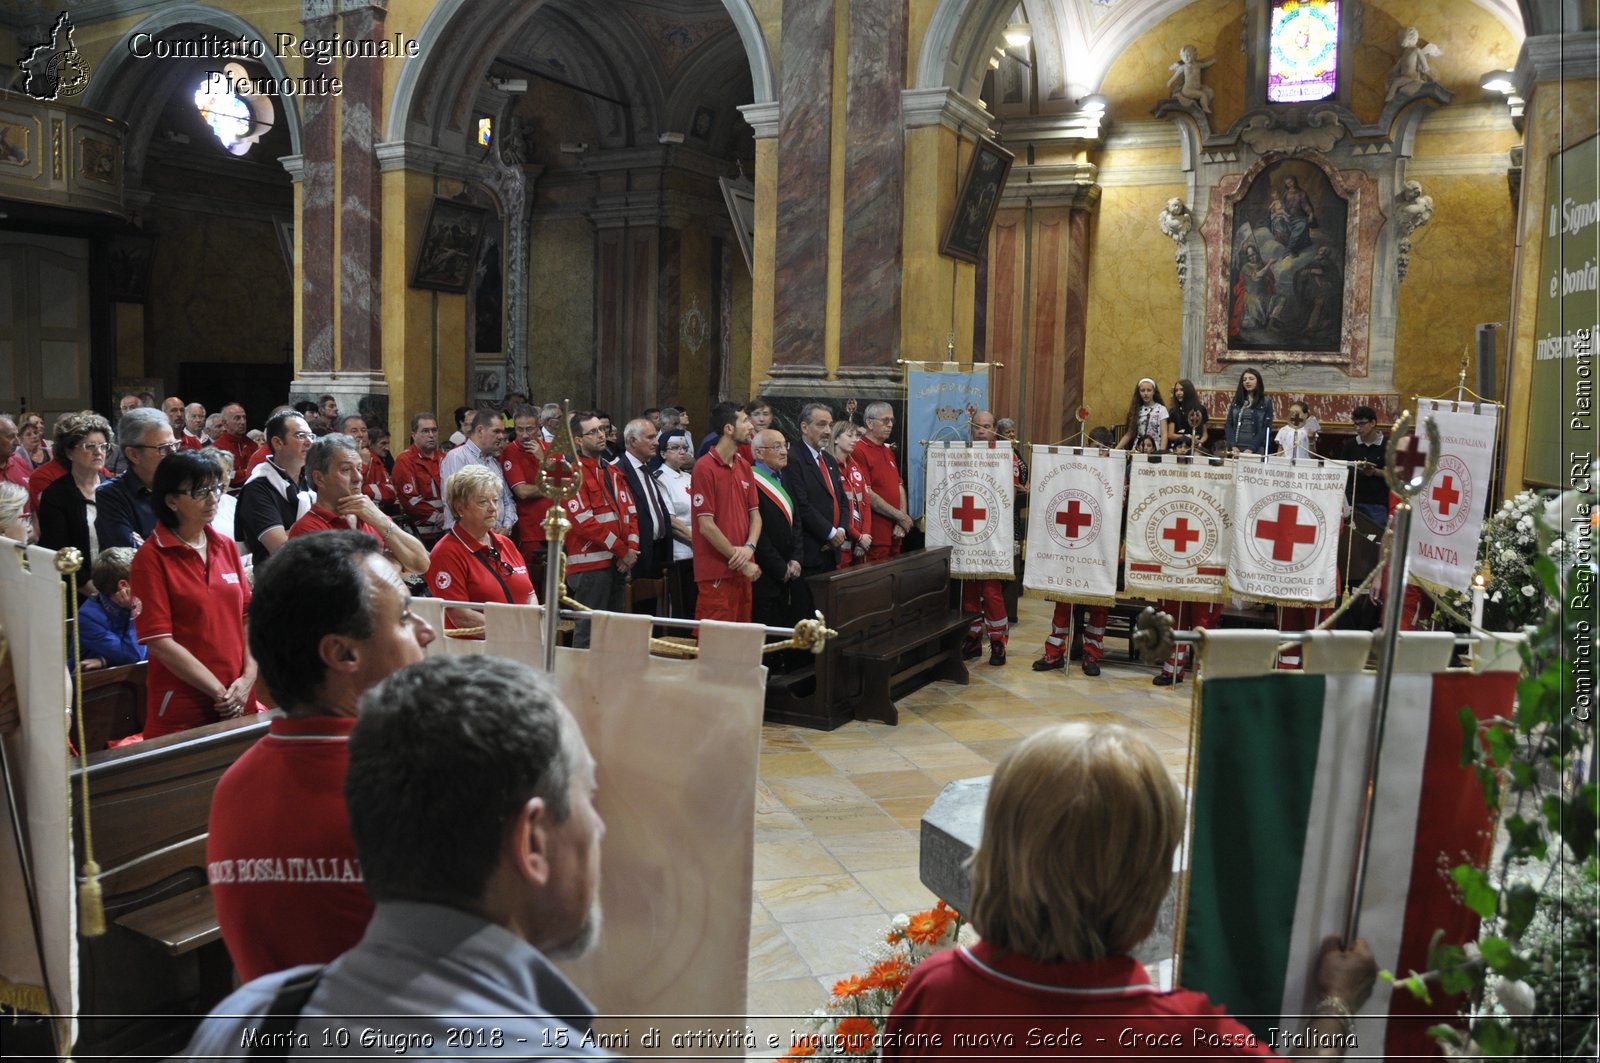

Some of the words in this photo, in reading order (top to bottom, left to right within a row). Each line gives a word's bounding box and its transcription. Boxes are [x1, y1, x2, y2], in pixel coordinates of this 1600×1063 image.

[1038, 468, 1059, 493] CROCE
[1060, 462, 1088, 471] ROSSA
[1088, 466, 1114, 499] ITALIANA
[1138, 468, 1156, 477] CORPO
[1158, 469, 1188, 478] VOLONTARI
[1204, 472, 1233, 480] SOCCORSO
[1243, 466, 1262, 475] CORPO
[1265, 469, 1295, 479] VOLONTARI
[1298, 472, 1309, 480] DEL
[1312, 473, 1340, 481] SOCCORSO
[928, 478, 948, 507] CROCE
[949, 469, 980, 480] ROSSA
[981, 474, 1012, 509] ITALIANA
[959, 483, 988, 496] GINEVRA
[1237, 475, 1269, 486] CROCE
[1272, 480, 1303, 489] ROSSA
[1305, 483, 1344, 491] ITALIANA
[1064, 491, 1088, 501] GINEVRA
[1131, 493, 1158, 522] CROCE
[1159, 485, 1195, 497] ROSSA
[1197, 489, 1233, 530] ITALIANA
[1159, 507, 1168, 516] DI
[1170, 503, 1203, 517] GINEVRA
[1248, 493, 1293, 519] CONVENZIONE
[1203, 517, 1213, 527] 22
[1147, 515, 1173, 564] CONVENZIONE
[1203, 528, 1216, 555] AGOSTO
[967, 549, 996, 557] LOCALE
[1036, 551, 1075, 563] COMITATO
[1077, 556, 1107, 567] LOCALE
[1418, 541, 1459, 566] MANTA
[965, 558, 1011, 567] DALMAZZO
[1066, 566, 1075, 574] DI
[1129, 572, 1173, 583] COMITATO
[1187, 577, 1224, 586] MONDOV
[1236, 569, 1277, 583] COMITATO
[1280, 576, 1314, 586] LOCALE
[1246, 583, 1313, 597] RACCONIGI
[236, 858, 286, 882] ROSSA
